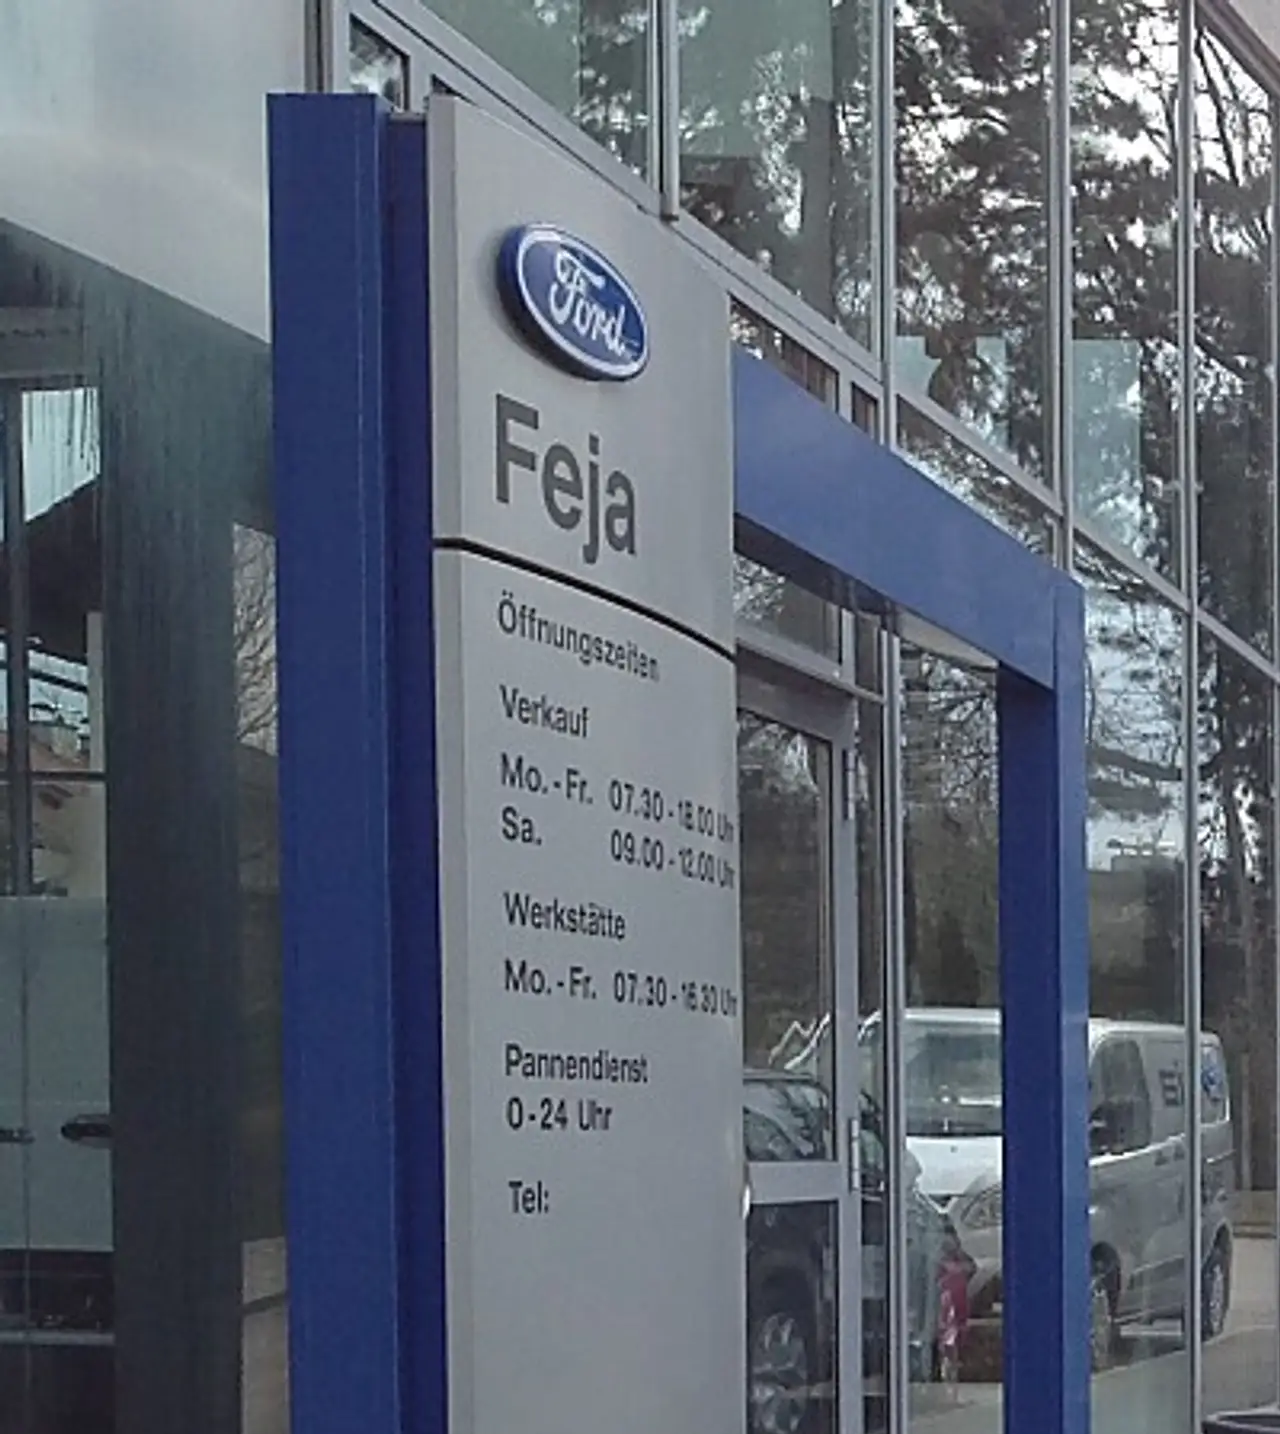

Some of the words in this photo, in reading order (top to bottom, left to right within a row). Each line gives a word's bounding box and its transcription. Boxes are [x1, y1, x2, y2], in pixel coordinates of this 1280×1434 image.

[548, 247, 639, 358] Ford
[495, 394, 637, 564] Feja
[499, 589, 659, 682] Öffnungszeiten
[500, 684, 589, 738] Verkauf
[501, 806, 542, 846] Sa.
[503, 891, 626, 941] Werkstätte
[505, 1044, 649, 1083] Pannendienst
[578, 1098, 613, 1131] Uhr
[508, 1180, 549, 1215] Tel:
